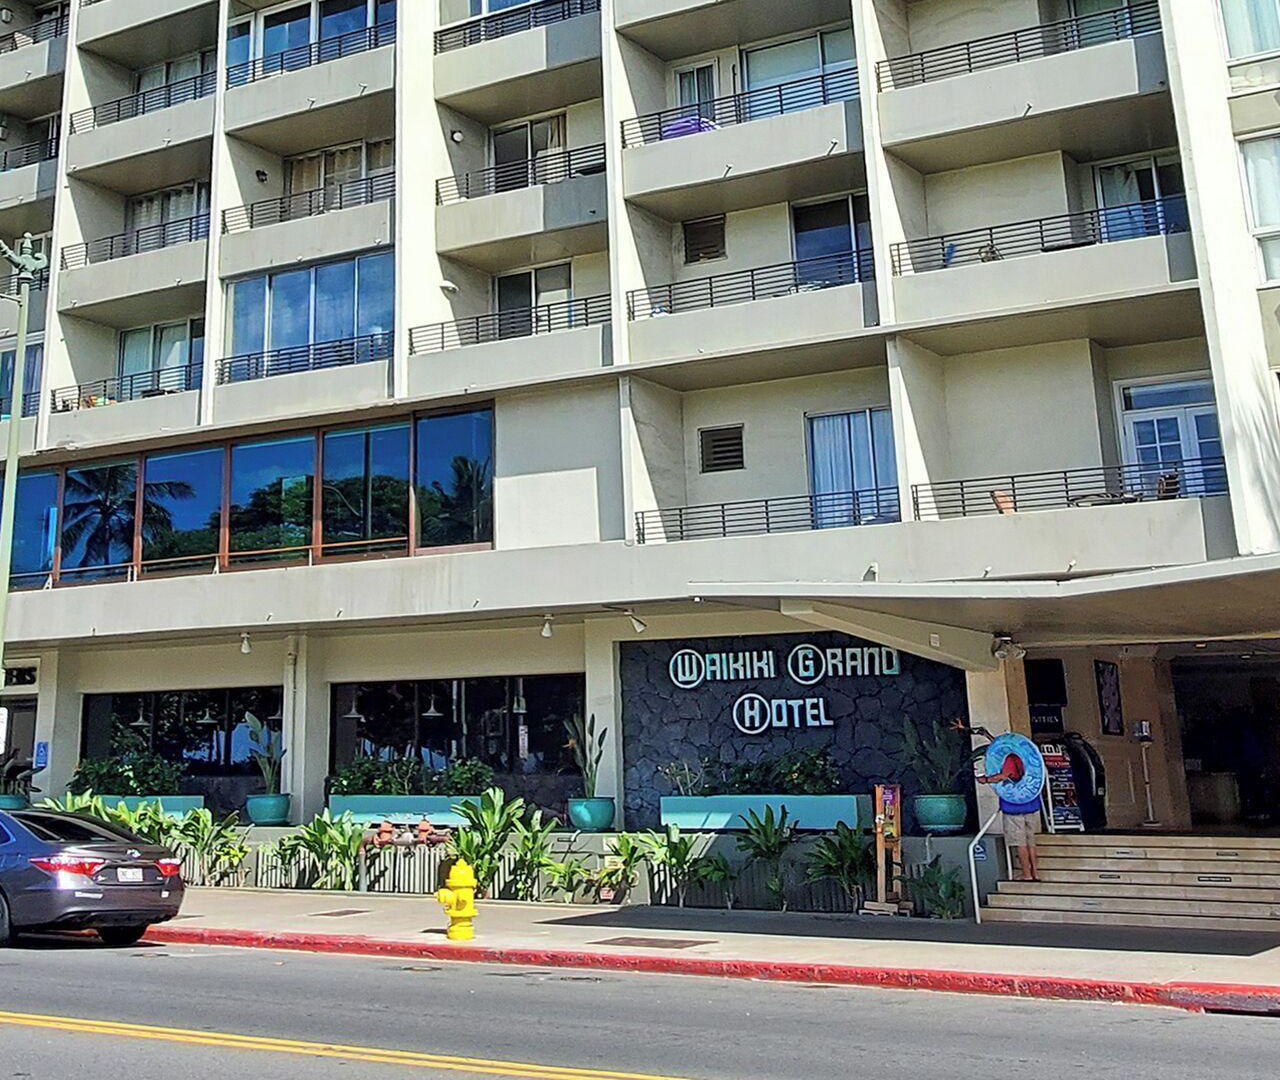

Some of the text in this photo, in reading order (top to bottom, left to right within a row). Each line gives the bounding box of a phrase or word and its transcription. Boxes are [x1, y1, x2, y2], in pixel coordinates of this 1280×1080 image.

[670, 644, 900, 689] WAIKIKI GRAND
[733, 693, 834, 734] HOTEL
